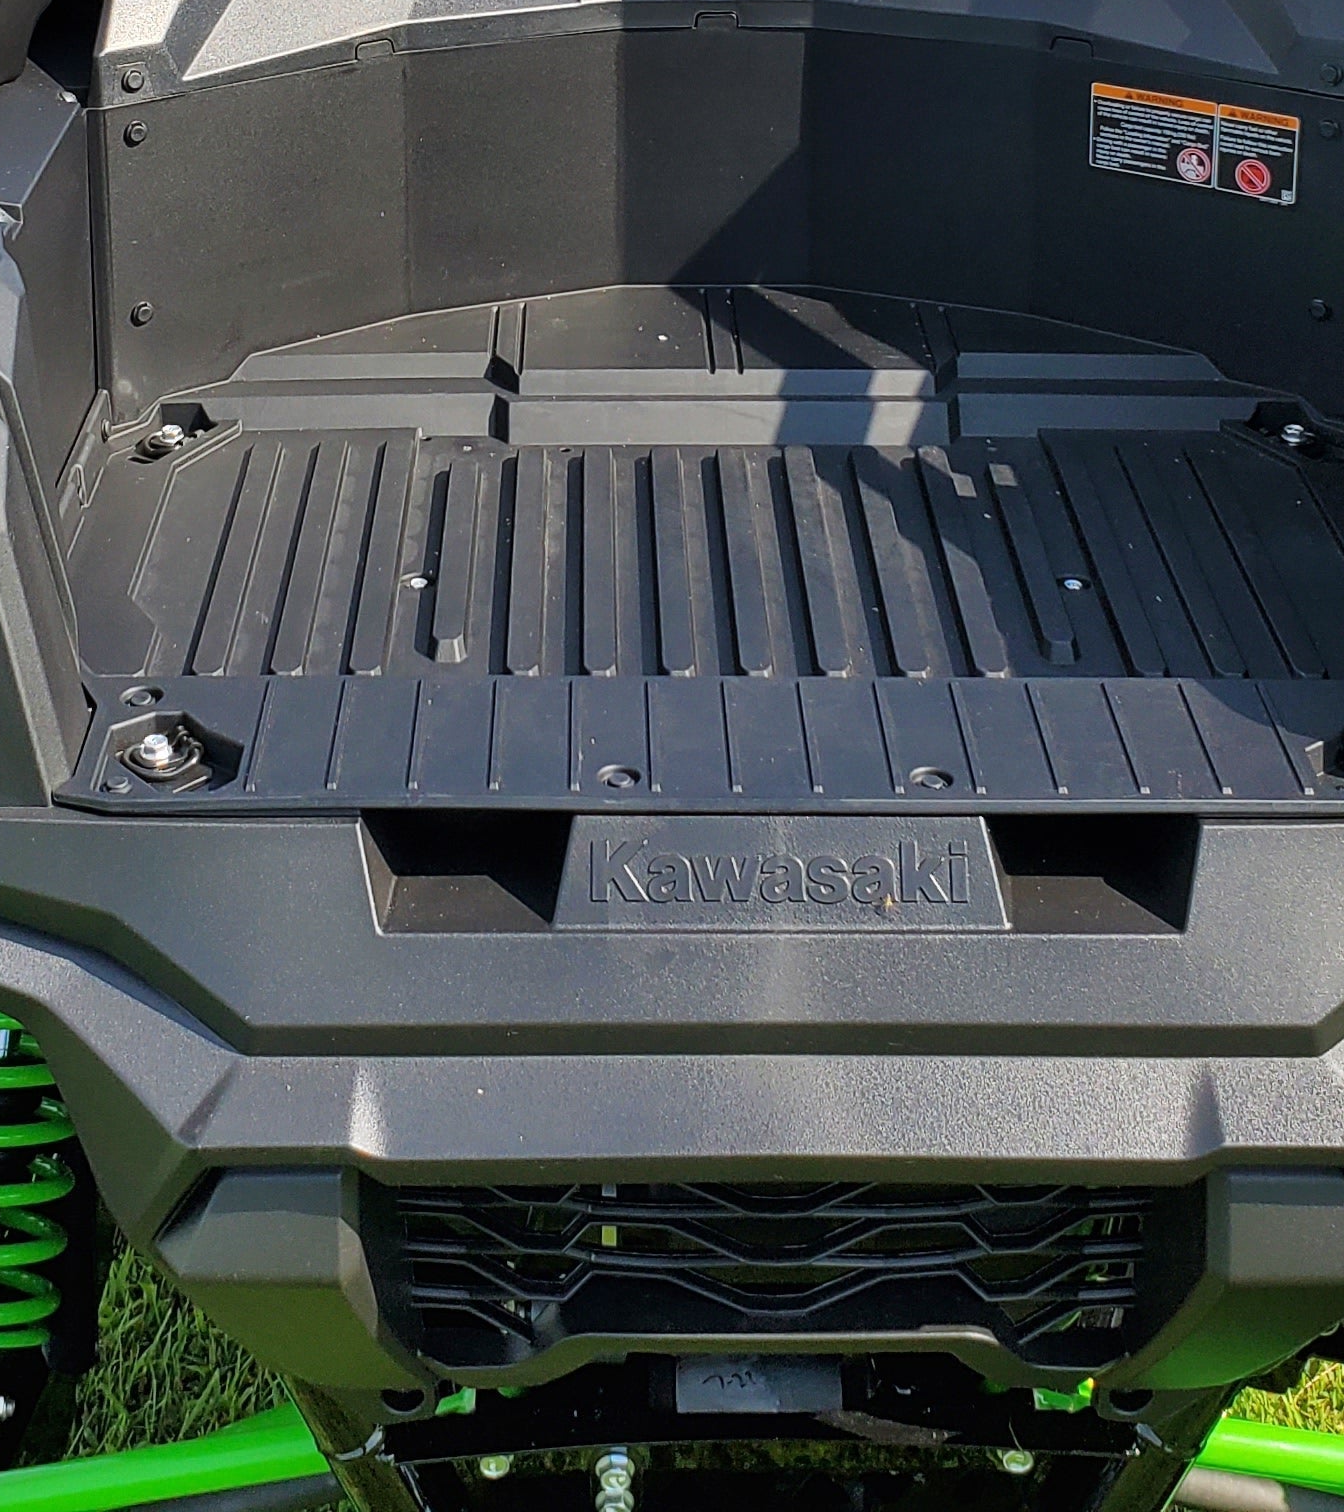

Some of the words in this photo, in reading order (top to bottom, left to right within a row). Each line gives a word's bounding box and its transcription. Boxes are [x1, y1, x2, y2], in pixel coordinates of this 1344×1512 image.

[1136, 93, 1184, 107] WARNING
[1240, 112, 1289, 127] WARNING
[589, 839, 970, 904] Kawasaki
